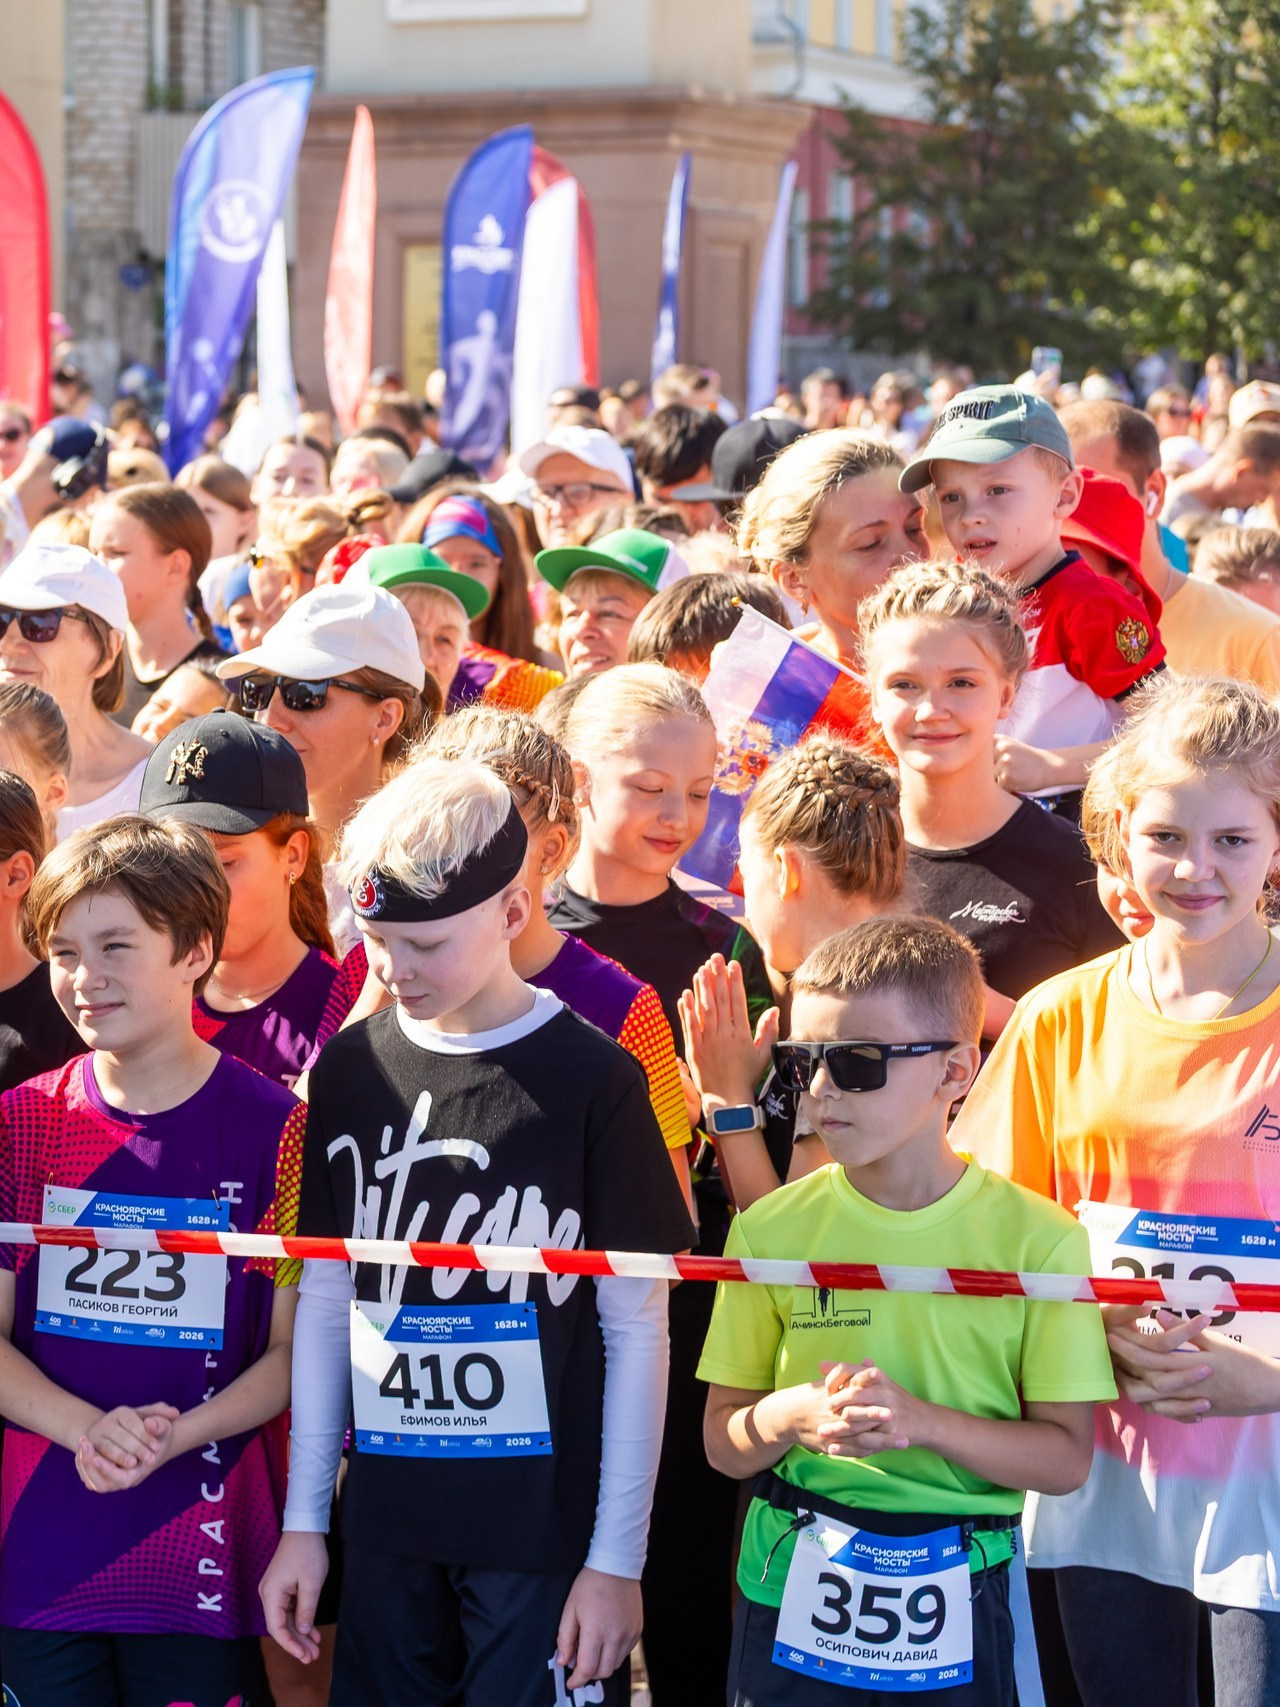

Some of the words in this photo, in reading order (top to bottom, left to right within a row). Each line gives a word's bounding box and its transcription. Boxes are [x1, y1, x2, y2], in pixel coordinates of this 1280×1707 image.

[57, 1204, 76, 1214] СБЕР
[95, 1203, 165, 1217] КРАСНОЯРСКИЕ
[112, 1213, 145, 1223] МОСТЫ
[187, 1216, 210, 1225] 1628
[1138, 1220, 1217, 1235] КРАСНОЯРСКИЕ
[1157, 1231, 1195, 1242] МОСТЫ
[1241, 1235, 1266, 1245] 1628
[1159, 1241, 1192, 1249] МАРАФОН
[65, 1246, 187, 1302] 223
[68, 1297, 119, 1313] ПАСИКОВ
[121, 1303, 178, 1318] ГЕОРГИЙ
[402, 1316, 471, 1325] КРАСНОЯРСКИЕ
[495, 1320, 518, 1329] 1628
[791, 1317, 868, 1330] АчинскБеговой
[420, 1325, 453, 1333] МОСТЫ
[179, 1331, 204, 1340] 2026
[379, 1352, 504, 1410] 410
[400, 1415, 451, 1427] ЕФИМОВ
[453, 1415, 487, 1427] ИЛЬЯ
[506, 1437, 532, 1447] 2026
[854, 1542, 929, 1558] КРАСНОЯРСКИЕ
[942, 1545, 957, 1557] 1628
[874, 1557, 911, 1567] МОСТЫ
[874, 1566, 908, 1574] МАРАФОН
[811, 1572, 946, 1645] 359
[815, 1637, 890, 1661] ОСИПОВИЧ
[892, 1648, 938, 1662] ДАВИД
[938, 1668, 959, 1680] 2026
